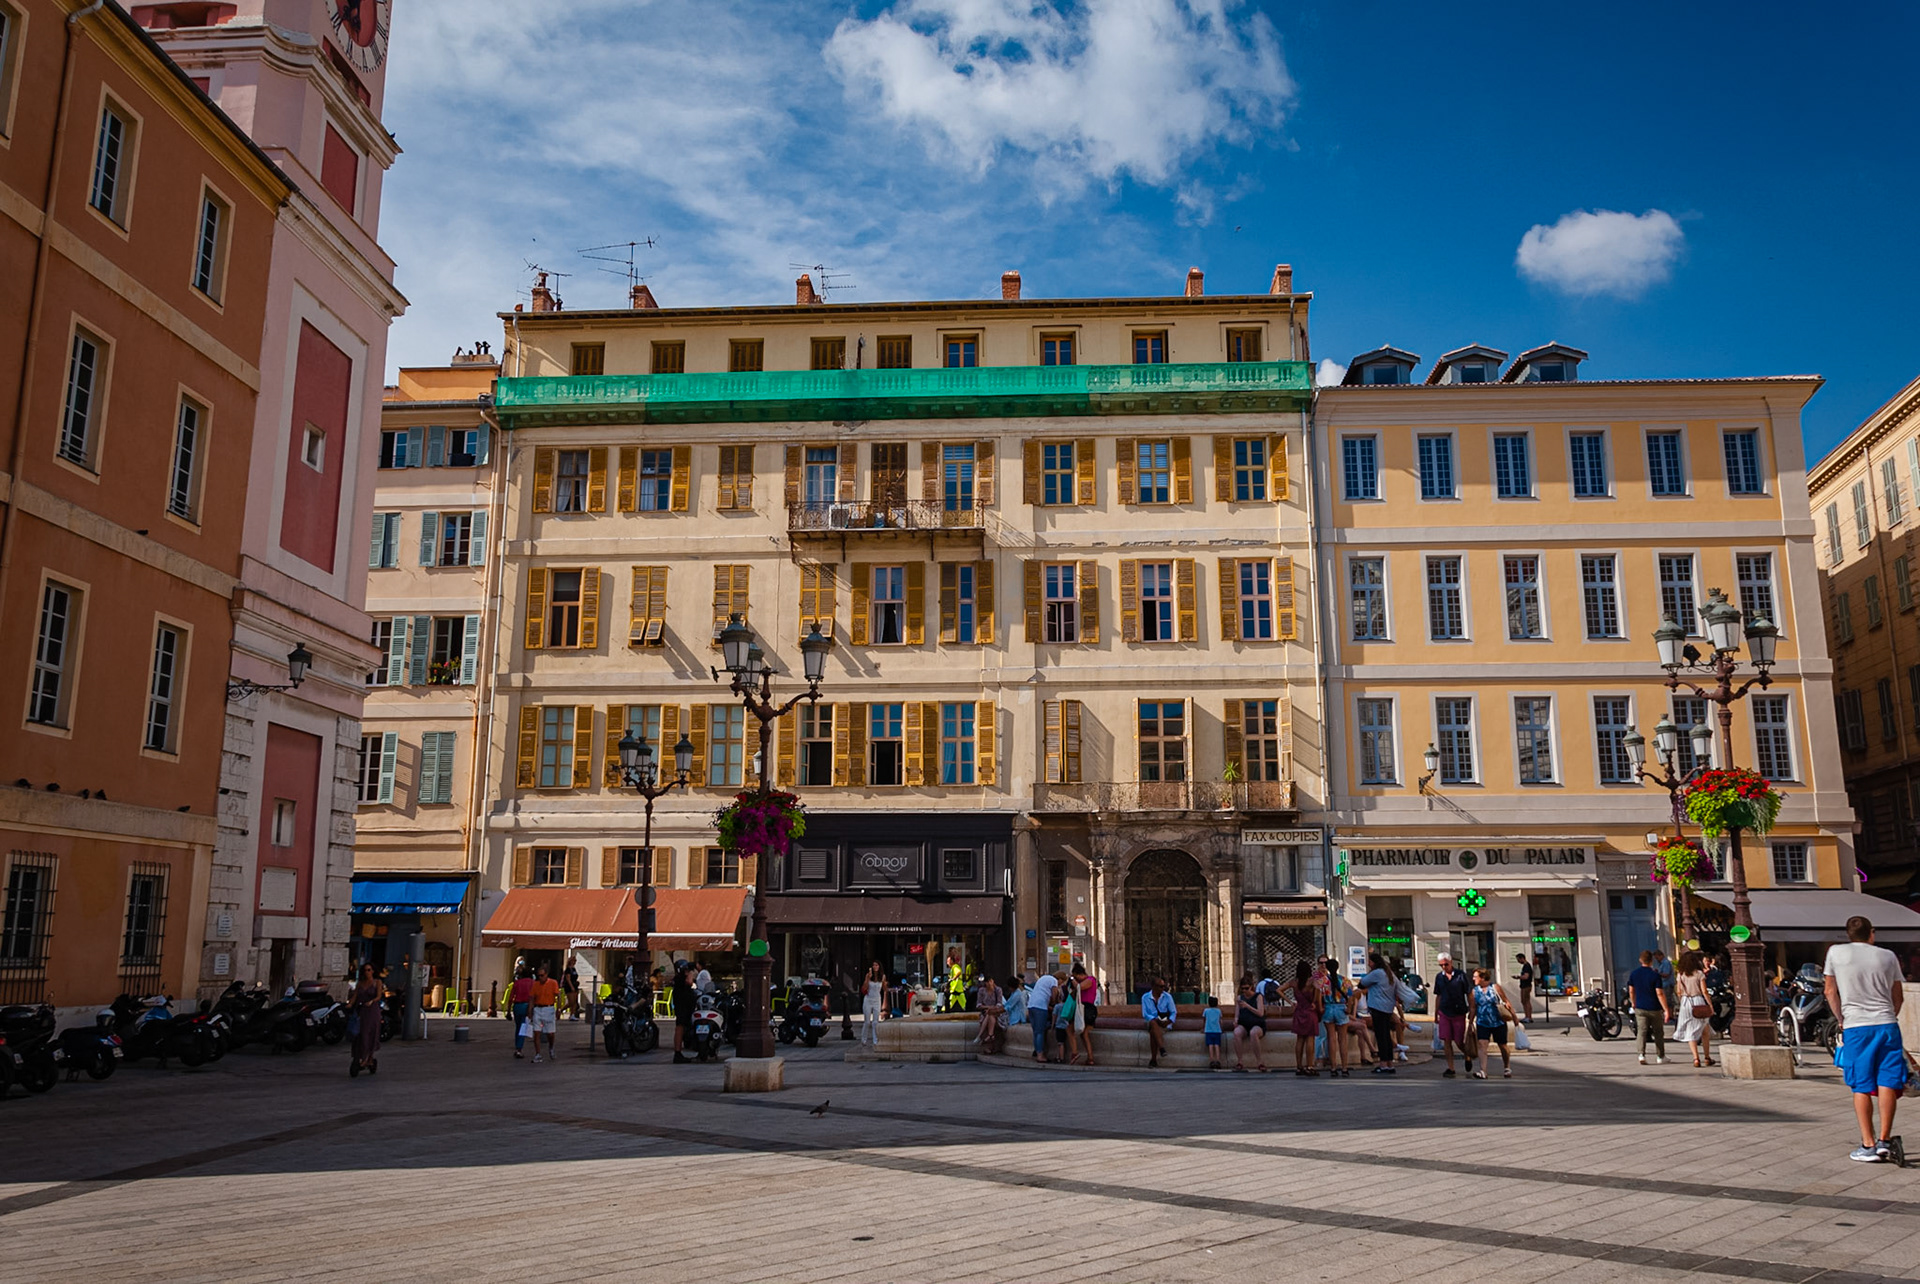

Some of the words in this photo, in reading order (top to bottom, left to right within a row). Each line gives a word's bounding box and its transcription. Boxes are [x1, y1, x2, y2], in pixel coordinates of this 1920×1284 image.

[1245, 832, 1267, 842] FAX
[1276, 831, 1319, 842] COPIES
[862, 855, 908, 869] ODDOU
[1351, 849, 1451, 866] PHARMACIE
[1485, 848, 1510, 865] DU
[1526, 848, 1585, 865] PALAIS
[570, 937, 601, 949] Glacier
[601, 938, 639, 949] Artisana
